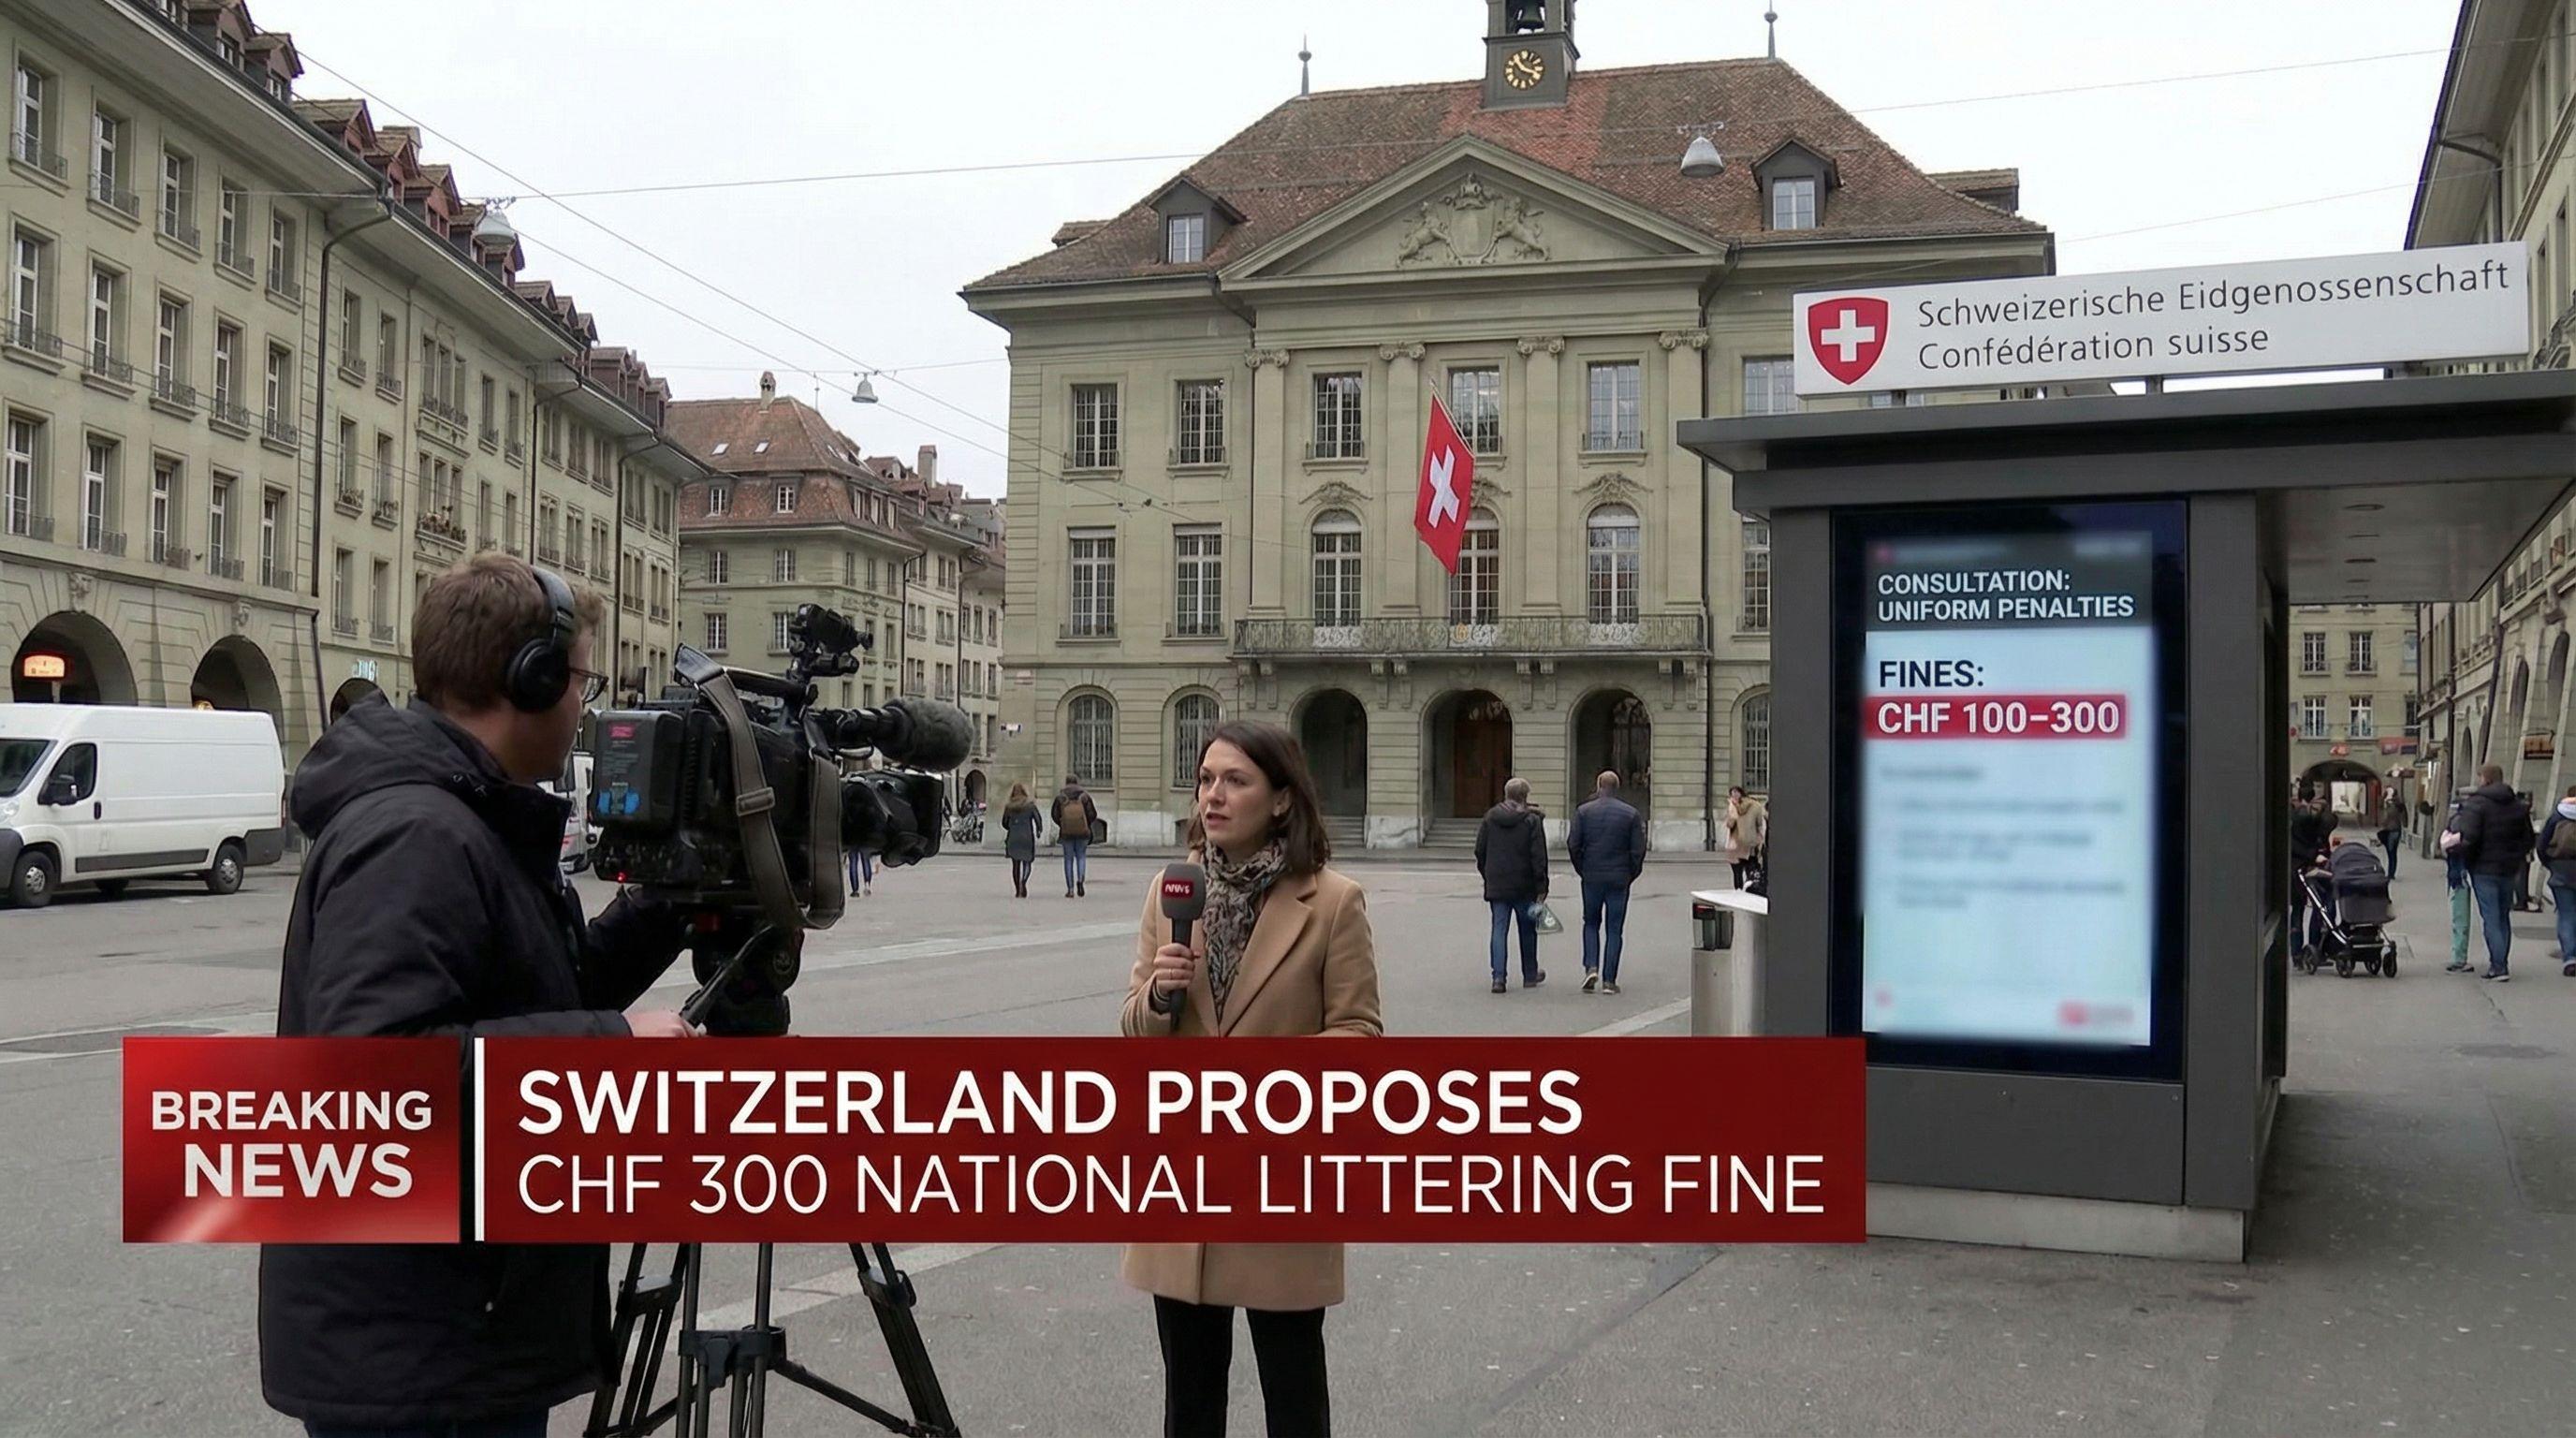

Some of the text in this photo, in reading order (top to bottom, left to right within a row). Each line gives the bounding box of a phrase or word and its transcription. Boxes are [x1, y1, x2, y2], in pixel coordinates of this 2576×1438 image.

[1919, 258, 2510, 328] Schweizerische Eidgenossenschaft
[1919, 326, 2269, 370] Confédération suisse
[1878, 569, 2071, 595] CONSULTATION:
[1878, 595, 2135, 622] UNIFORM PENALTIES
[1879, 659, 1984, 688] FINES:
[1878, 702, 1951, 734] CHF
